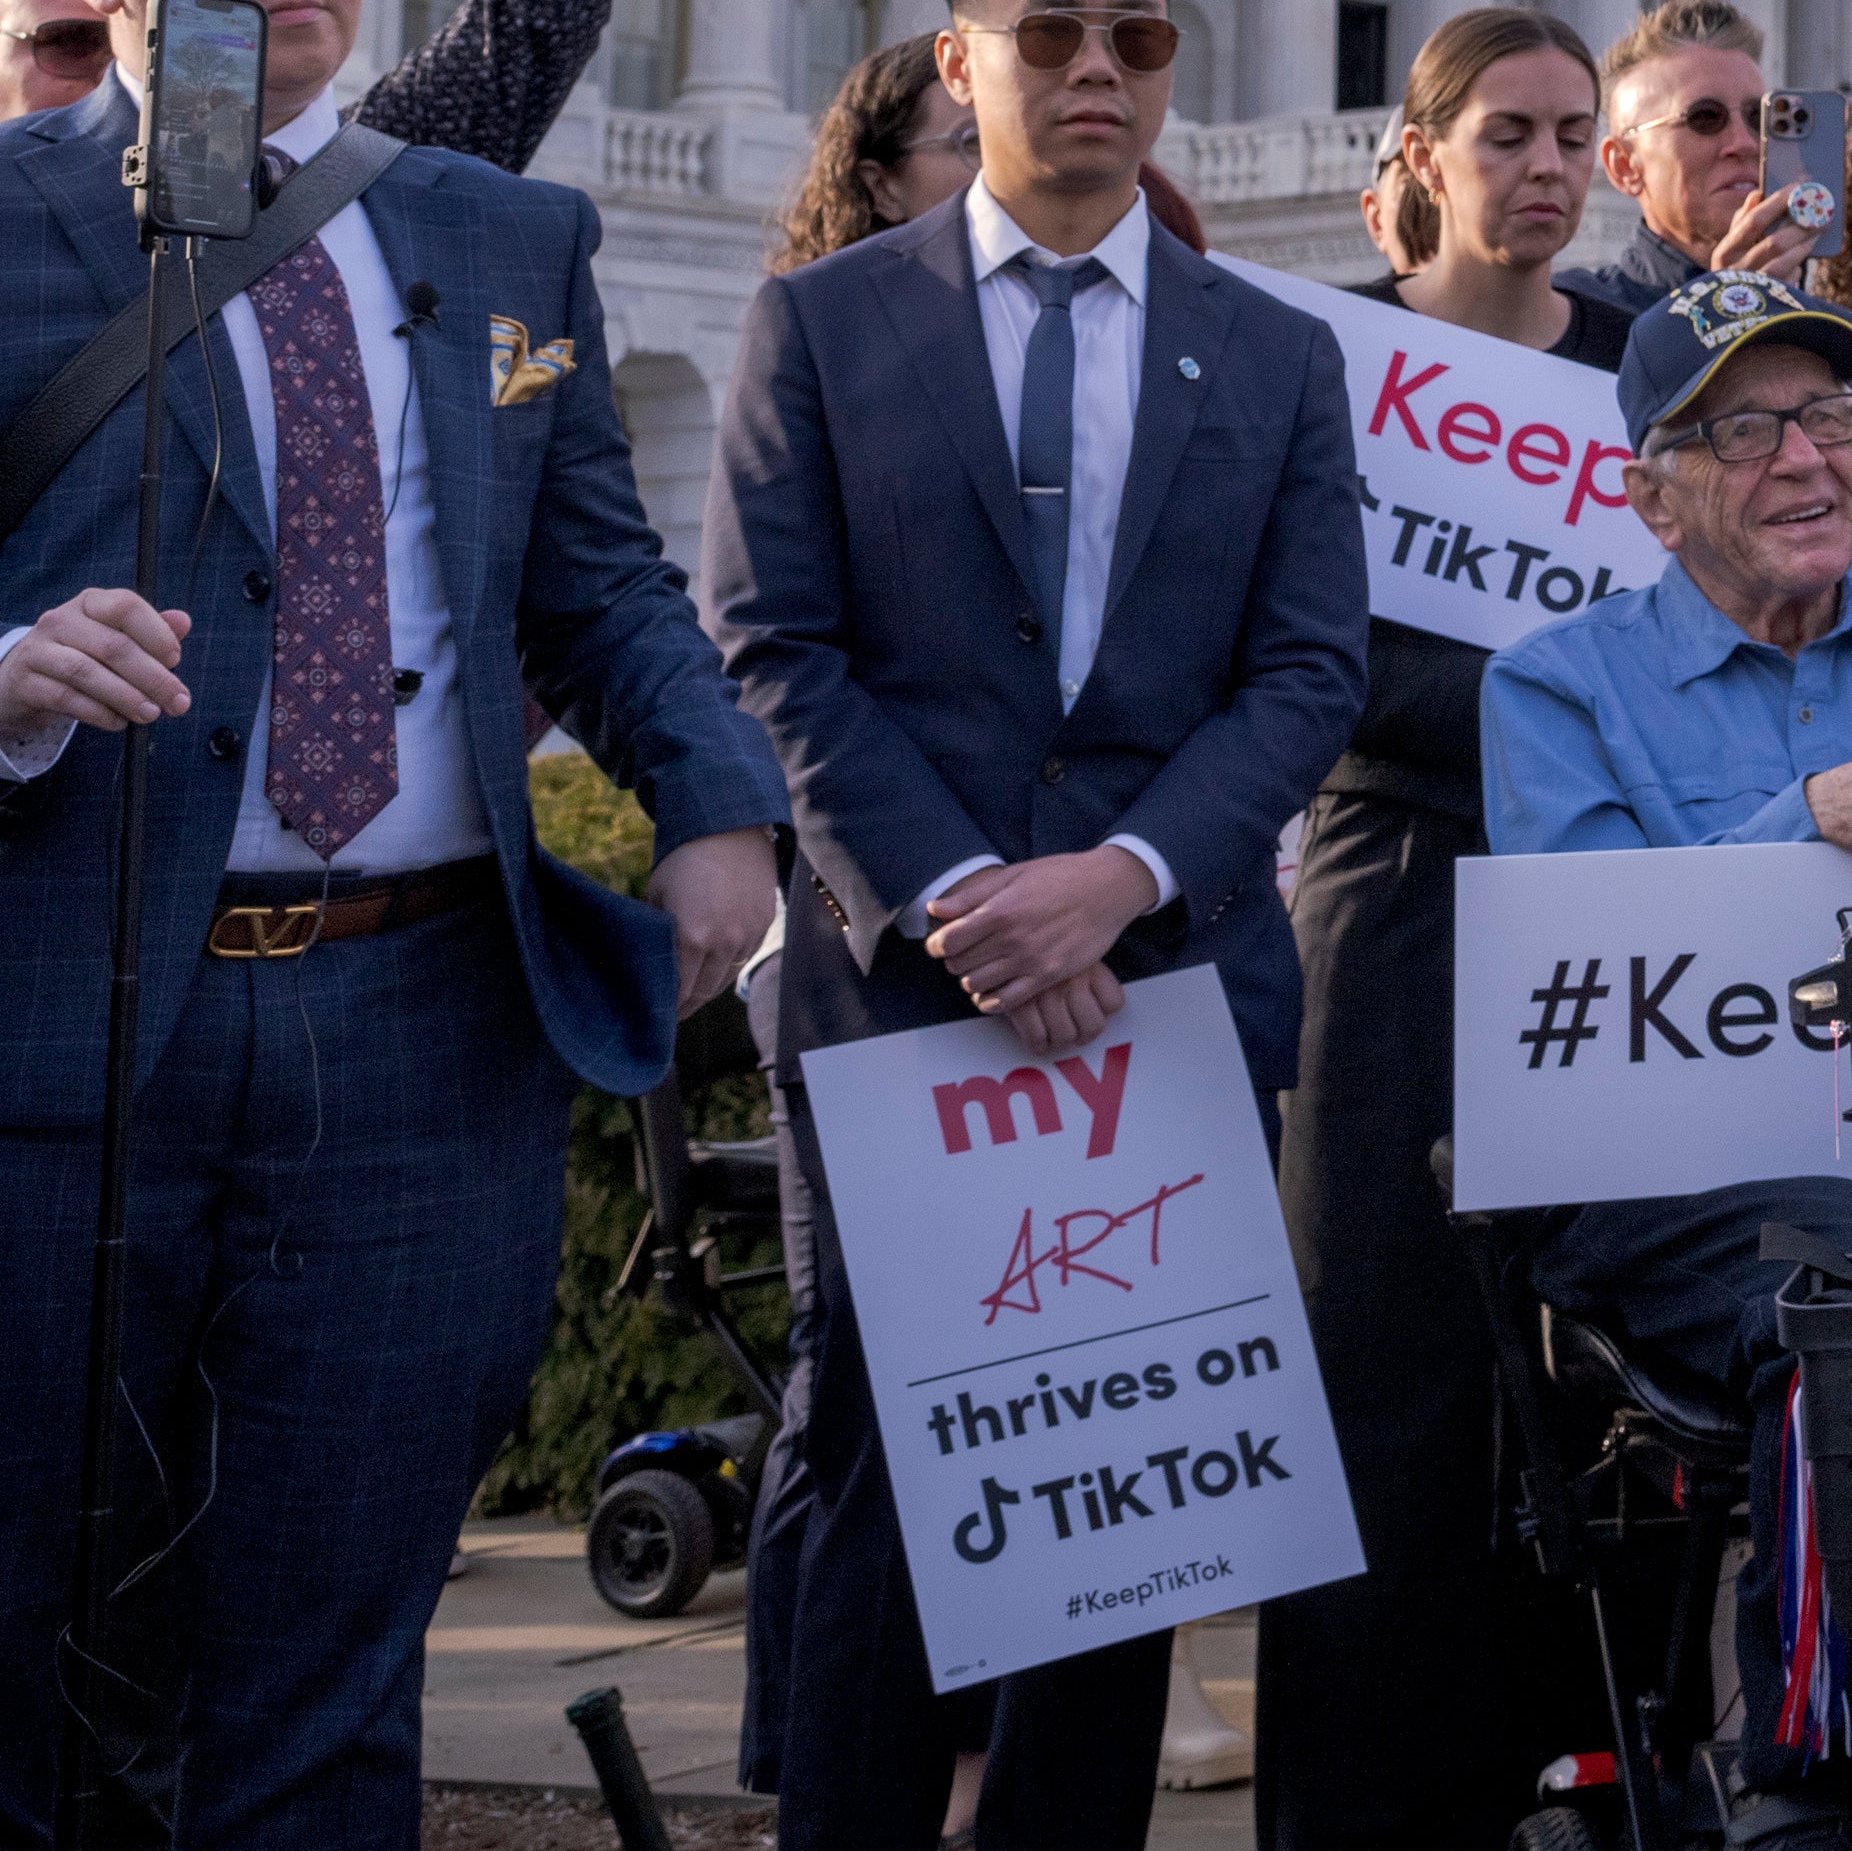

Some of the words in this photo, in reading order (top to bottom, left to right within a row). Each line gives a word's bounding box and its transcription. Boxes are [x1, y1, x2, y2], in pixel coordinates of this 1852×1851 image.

[1369, 351, 1634, 526] Keep
[931, 1042, 1133, 1161] my
[980, 1174, 1205, 1326] ART
[928, 1361, 1176, 1455] thrives
[1196, 1335, 1282, 1386] on
[1033, 1430, 1292, 1540] TikTok
[1065, 1555, 1235, 1620] #KeepTikTok
